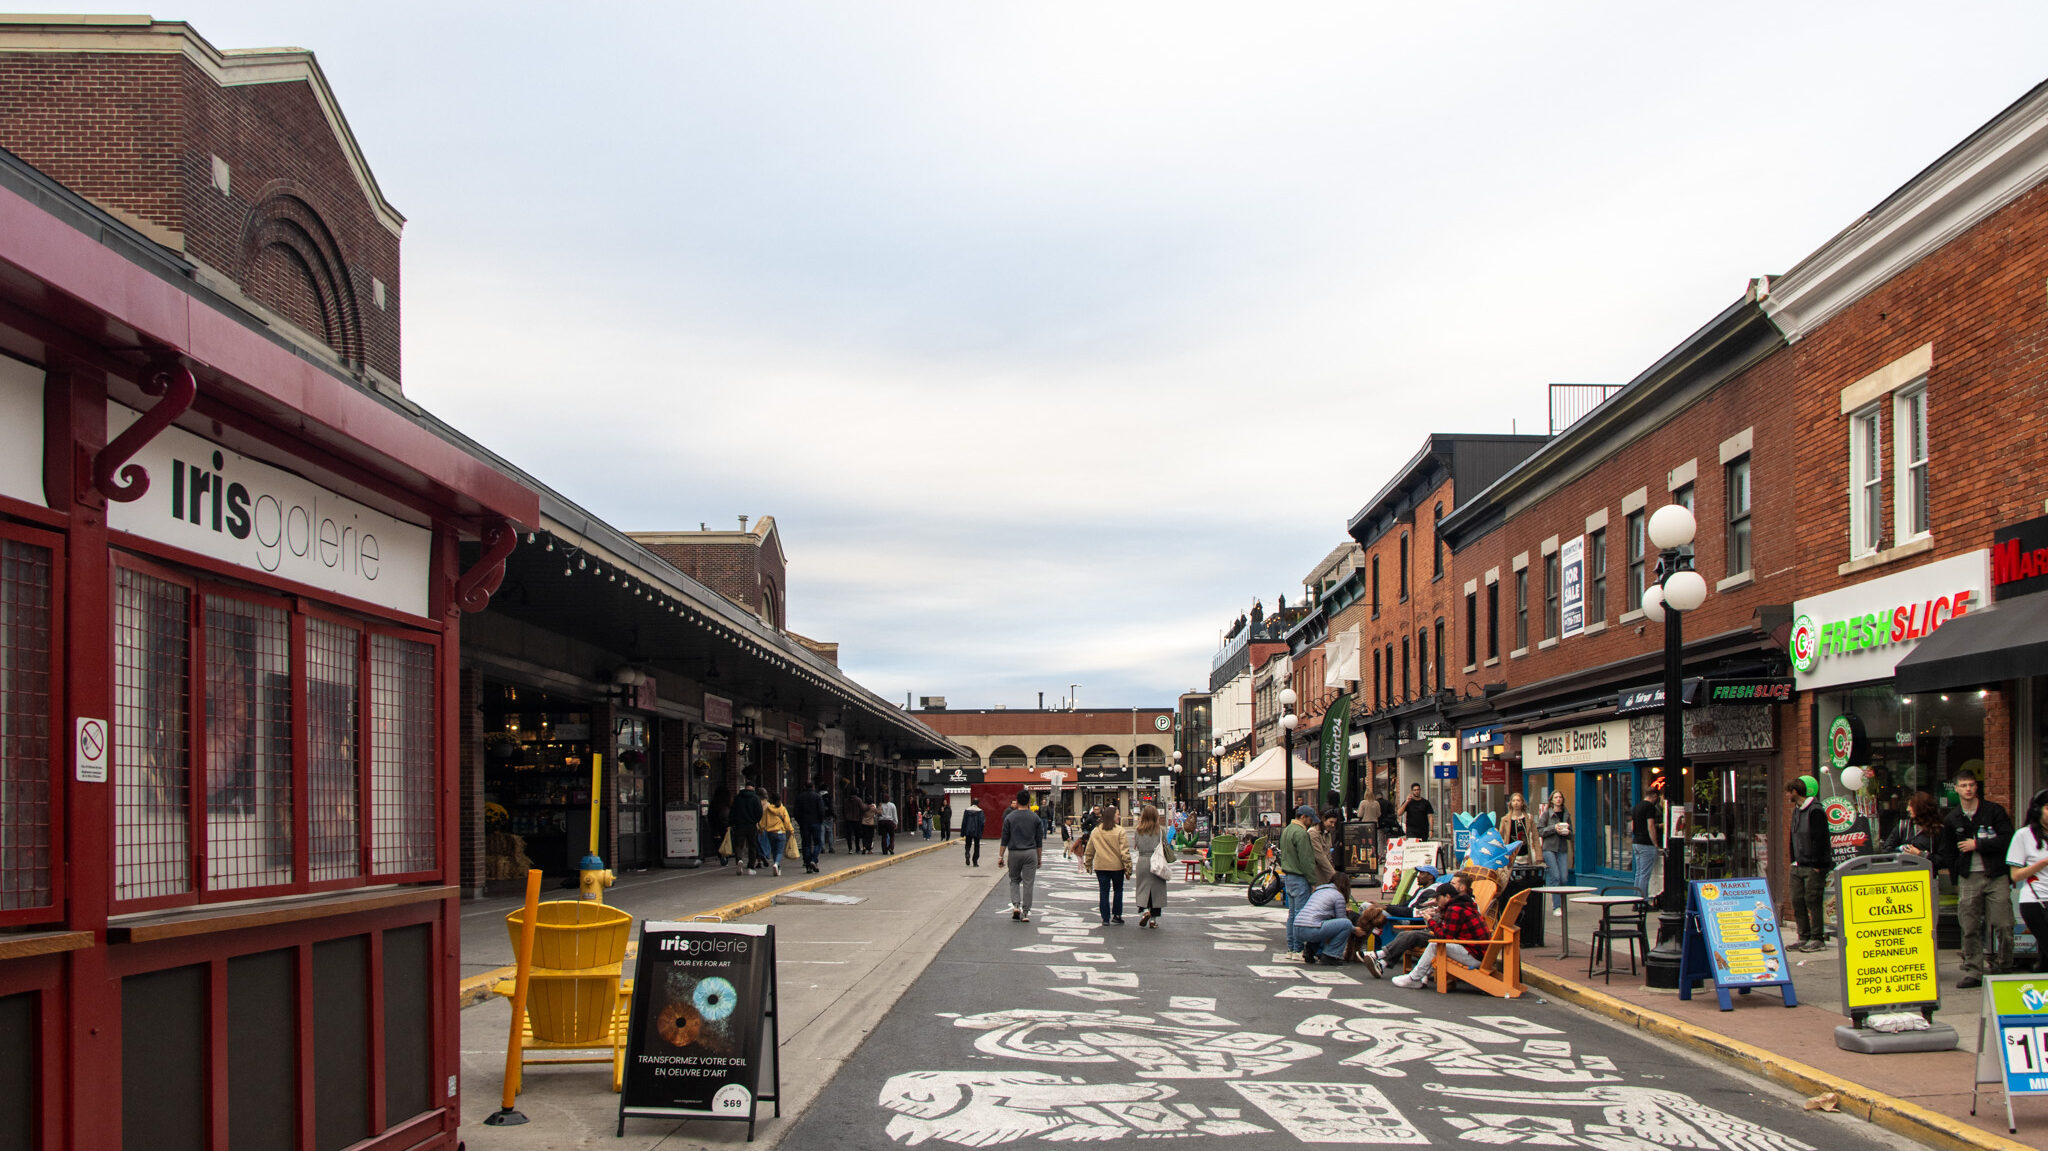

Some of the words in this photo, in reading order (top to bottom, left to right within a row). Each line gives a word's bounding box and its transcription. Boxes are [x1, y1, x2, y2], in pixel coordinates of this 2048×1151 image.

[1994, 537, 2048, 585] MAR
[1565, 566, 1579, 585] FOR
[1564, 583, 1580, 604] SALE
[1817, 590, 1973, 657] FRESHSLICE
[1713, 684, 1791, 699] FRESHSLICE
[1537, 736, 1563, 755] Beans
[1572, 725, 1607, 752] Barrels
[1896, 731, 1912, 744] Open
[1330, 718, 1343, 793] KaleMart24
[1723, 889, 1766, 897] ACCESSORIES
[1890, 884, 1919, 894] MAGS
[1885, 896, 1893, 904] &
[1869, 904, 1913, 916] CIGARS
[1856, 926, 1922, 939] CONVENIENCE
[1875, 938, 1905, 947] STORE
[1863, 947, 1918, 958] DEPANNEUR
[1857, 966, 1888, 976] CUBAN
[1891, 963, 1925, 973] COFFEE
[1856, 976, 1882, 985] ZIPPO
[1885, 973, 1928, 983] LIGHTERS
[1864, 986, 1882, 994] POP
[1885, 985, 1891, 993] &
[1895, 983, 1921, 992] JUICE
[638, 1055, 698, 1065] TRANSFORMEZ
[699, 1056, 727, 1066] VOTRE
[729, 1057, 747, 1066] OEIL
[654, 1068, 666, 1076] EN
[667, 1068, 701, 1077] OEUVRE
[1238, 1084, 1366, 1096] START
[723, 1099, 742, 1108] $69
